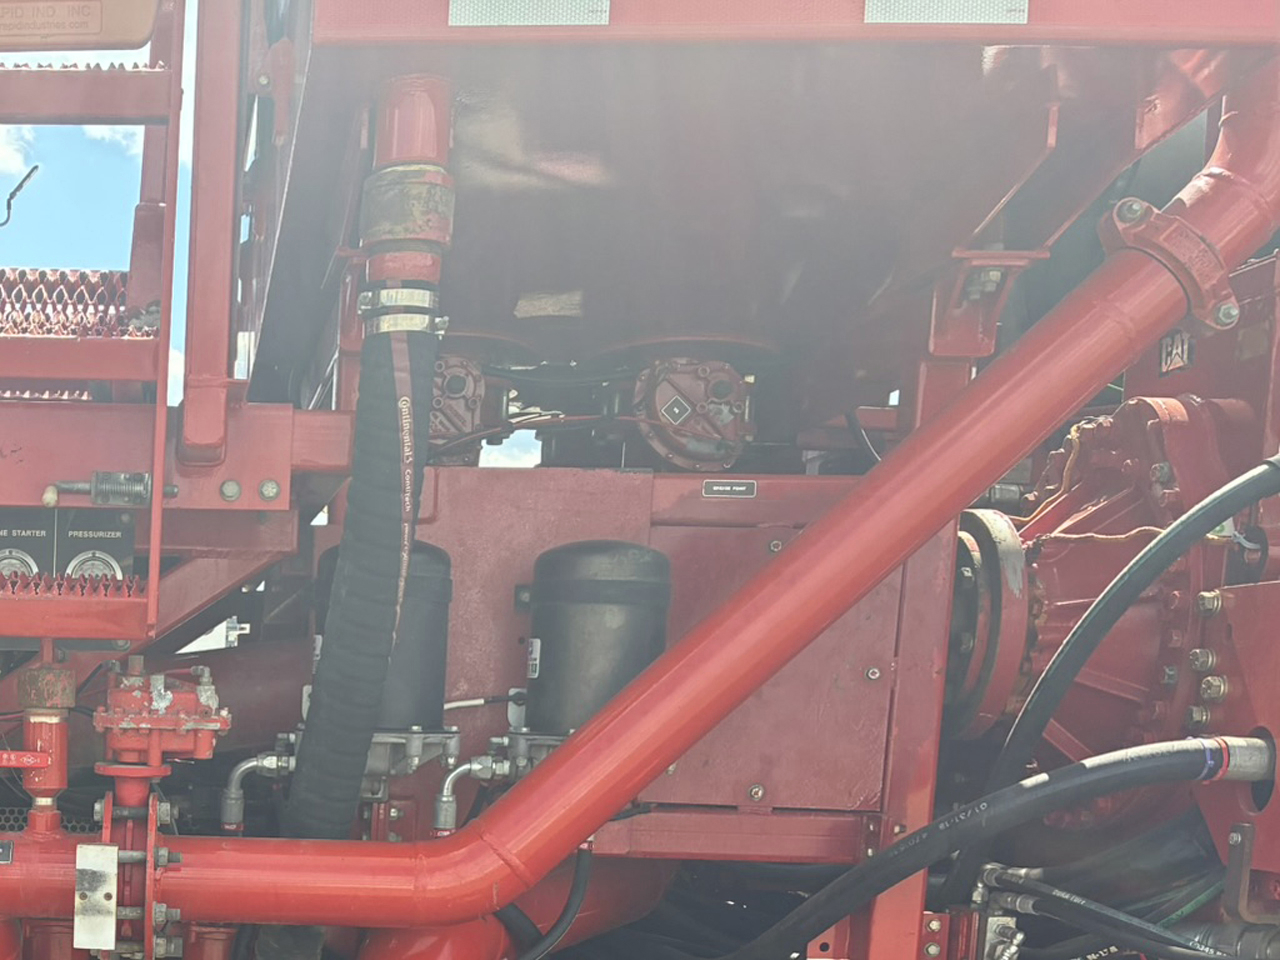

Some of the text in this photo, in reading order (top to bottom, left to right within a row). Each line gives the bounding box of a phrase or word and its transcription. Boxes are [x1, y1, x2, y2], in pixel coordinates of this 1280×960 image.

[31, 5, 56, 18] IND
[67, 5, 91, 17] INC
[11, 529, 46, 537] STARTER
[68, 530, 121, 538] PRESSURIZER
